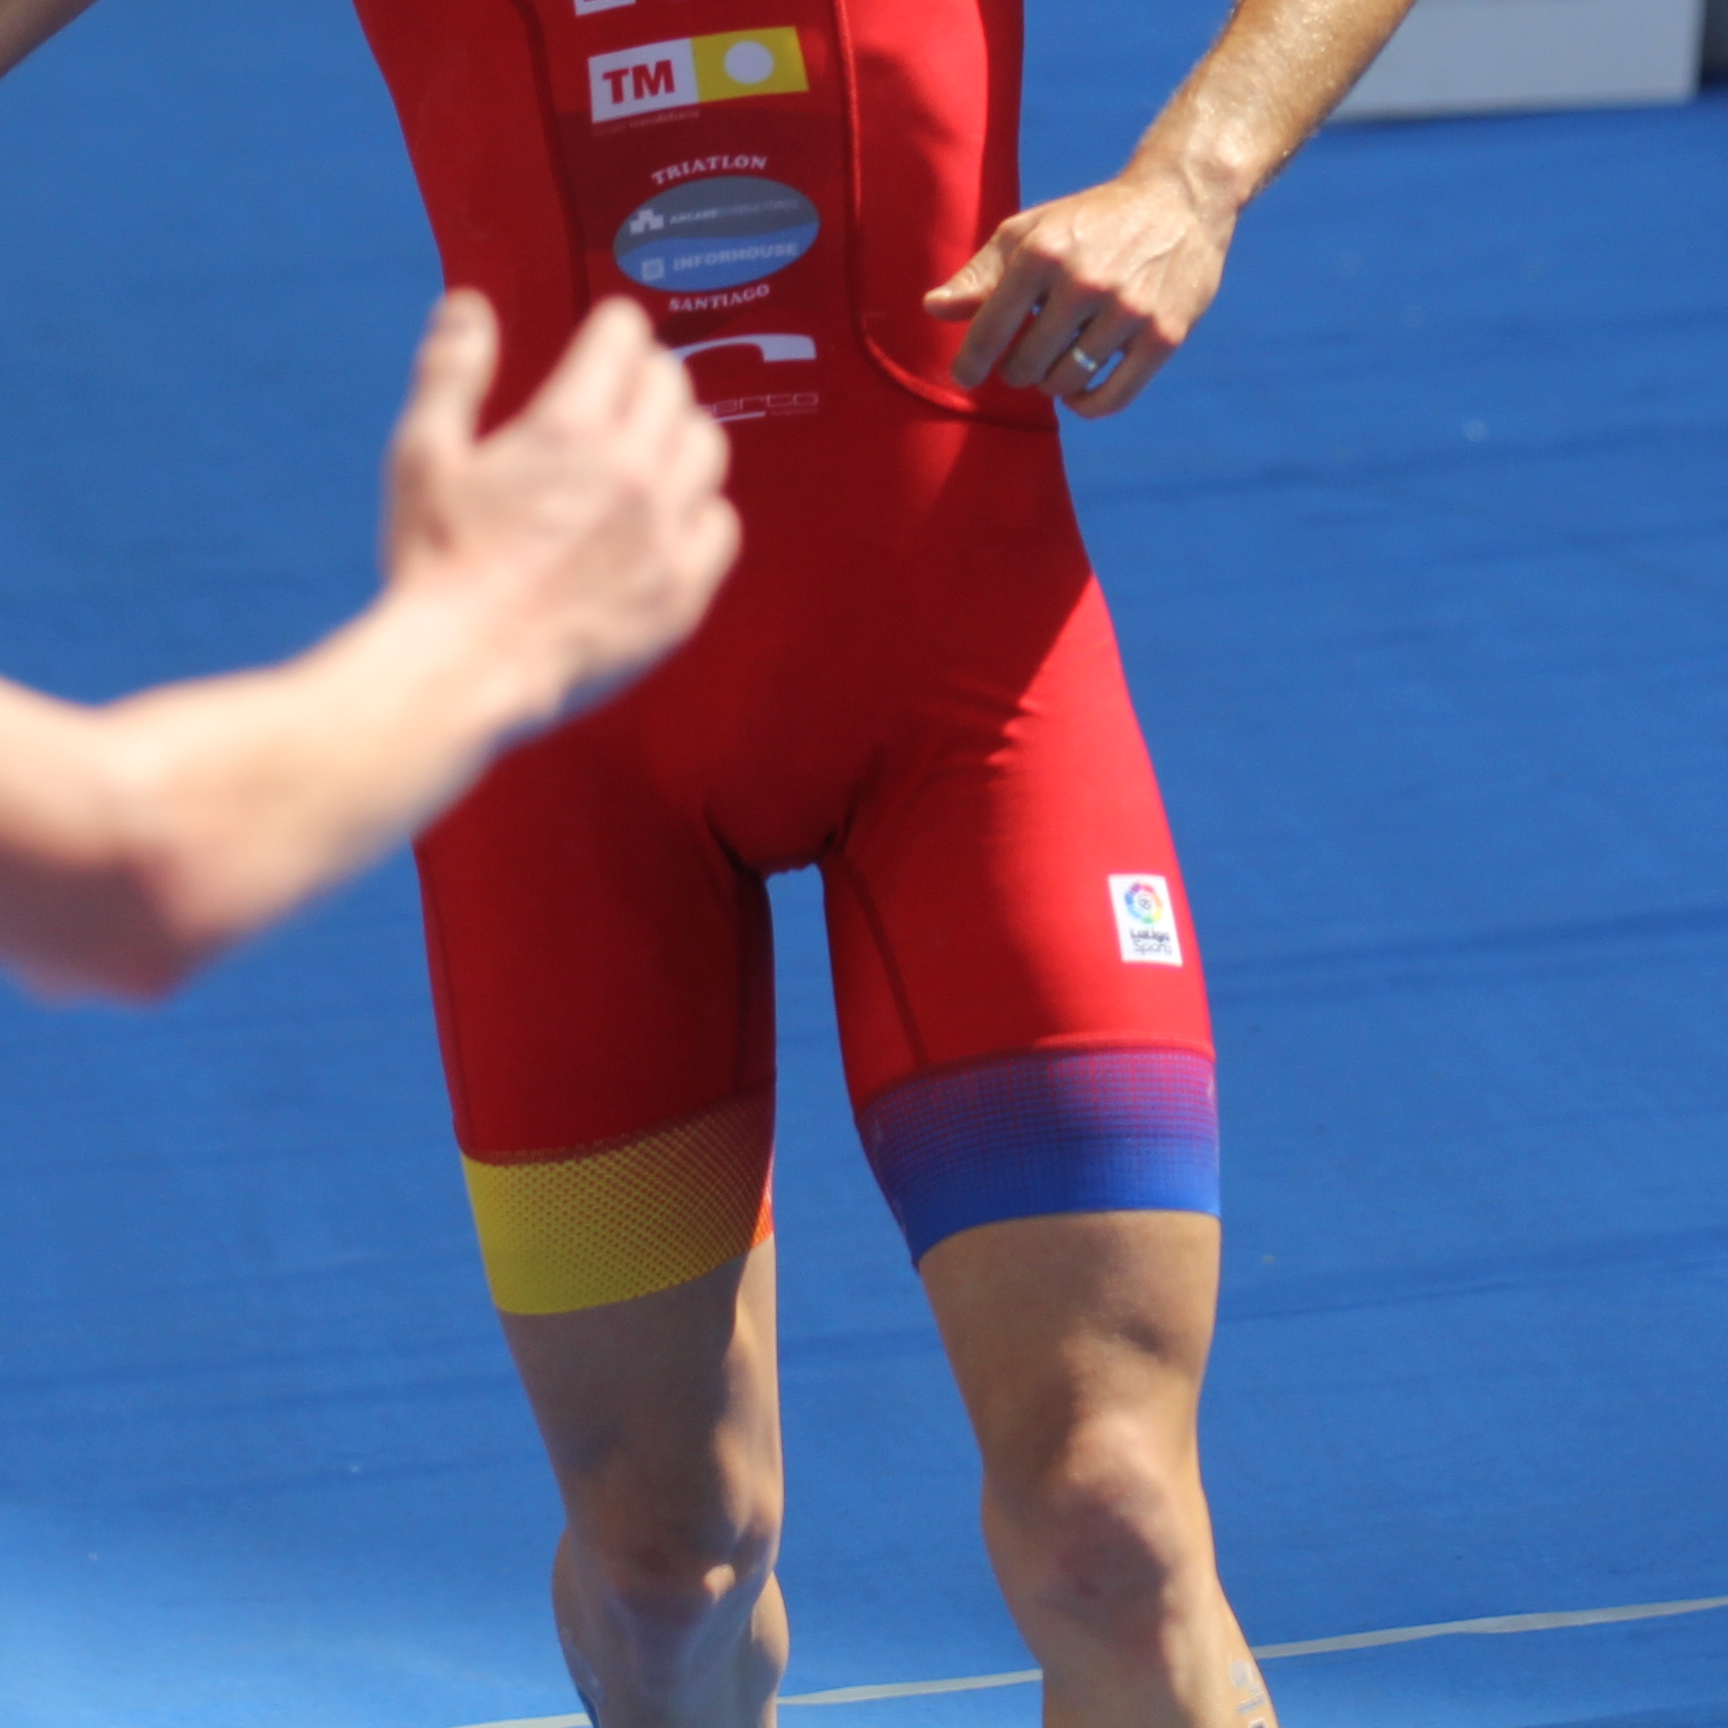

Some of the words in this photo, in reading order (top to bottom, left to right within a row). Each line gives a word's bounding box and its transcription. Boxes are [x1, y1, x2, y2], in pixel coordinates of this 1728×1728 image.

[602, 58, 676, 106] TM
[651, 155, 769, 186] TRIATLON
[668, 283, 770, 313] SANTIAGO
